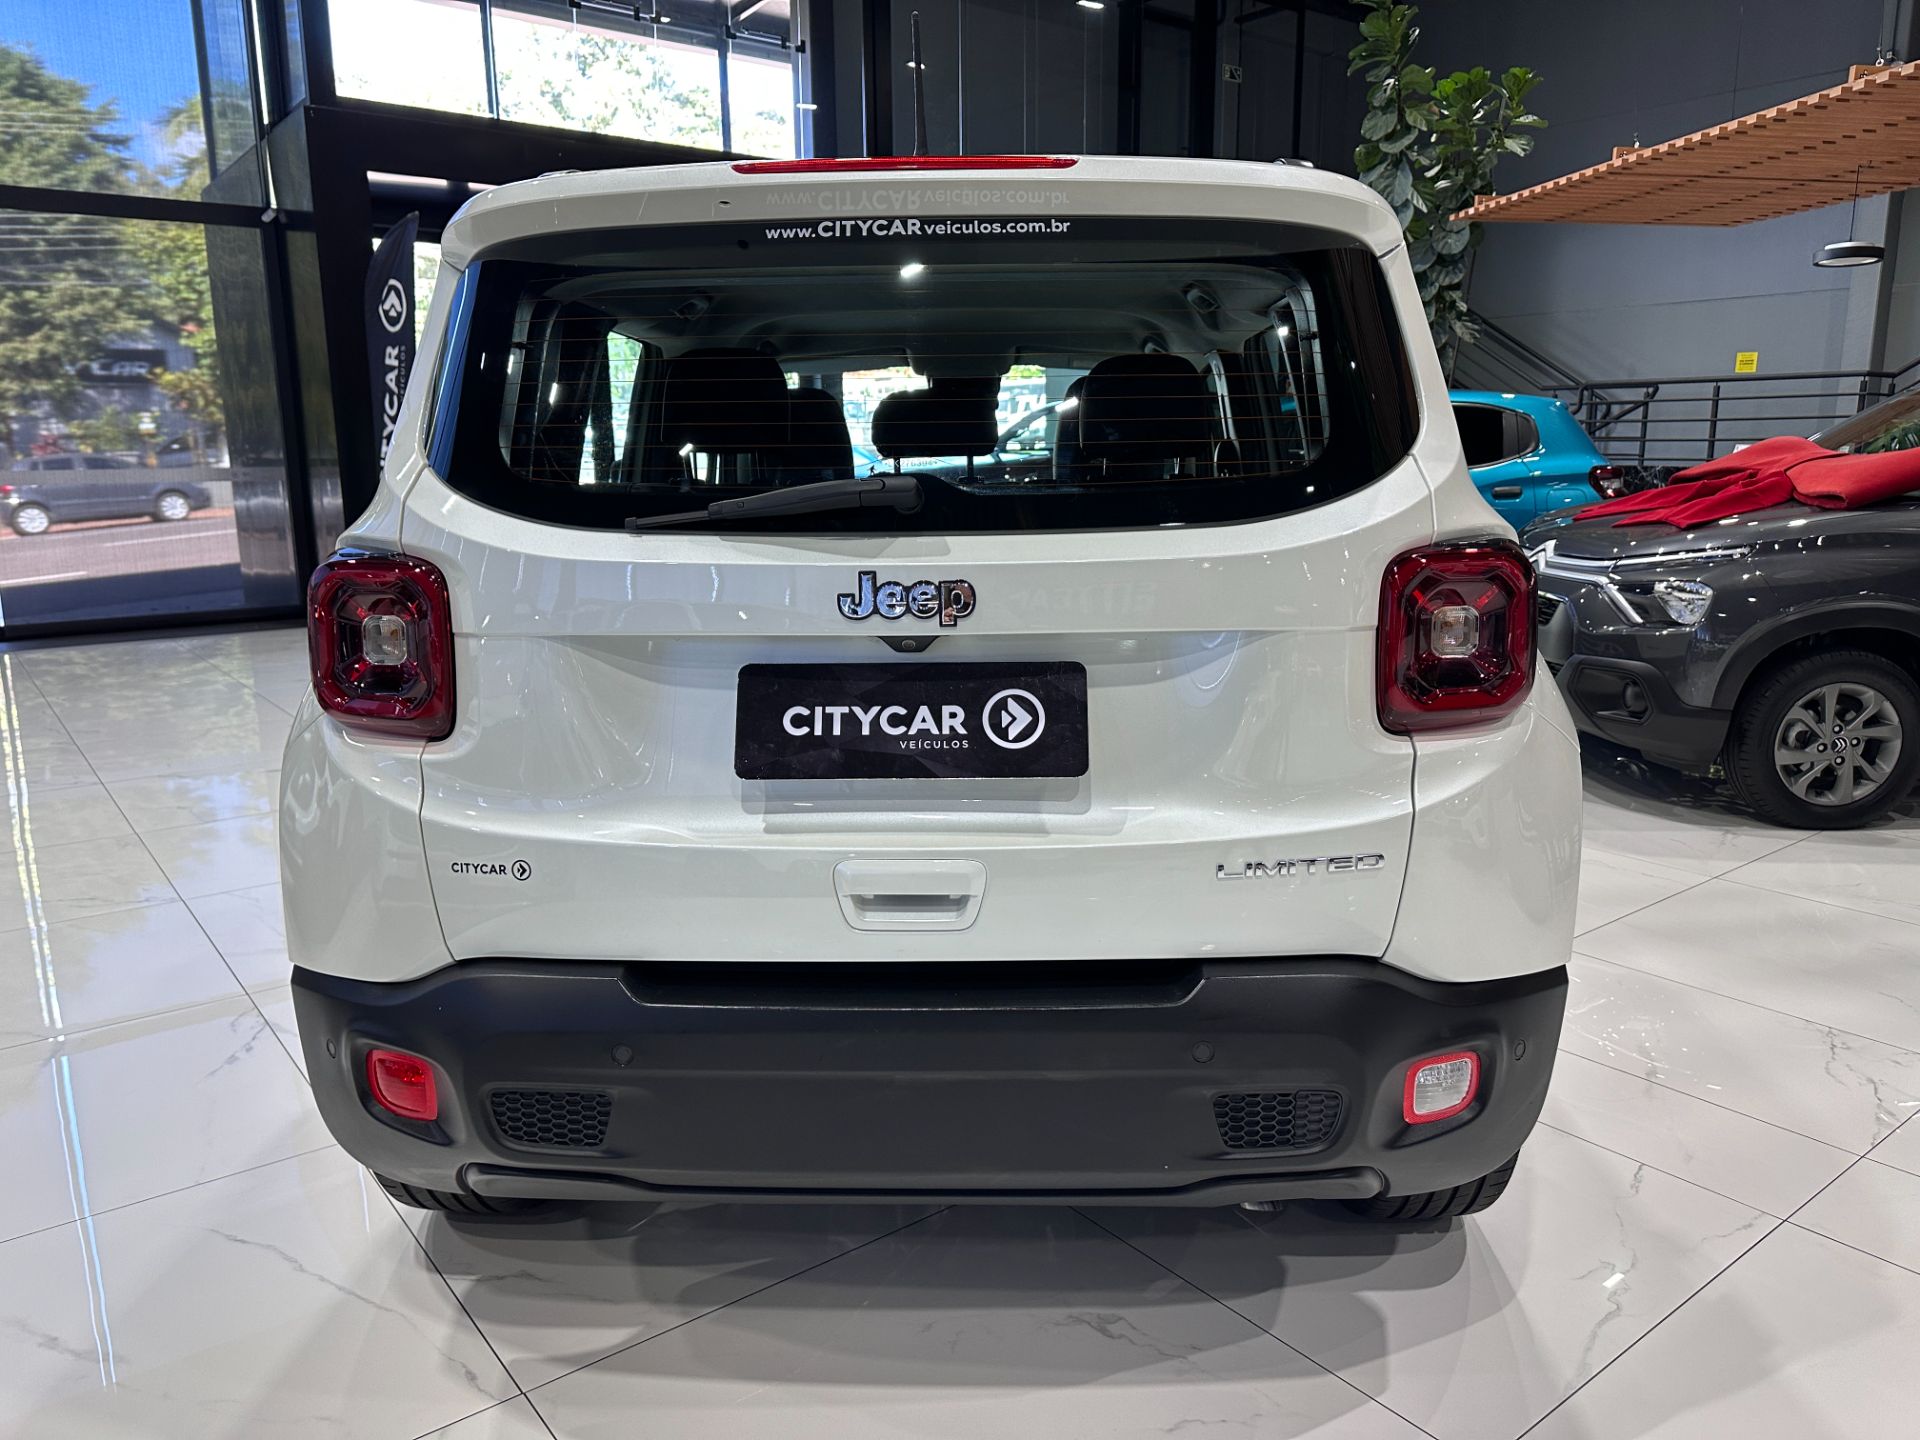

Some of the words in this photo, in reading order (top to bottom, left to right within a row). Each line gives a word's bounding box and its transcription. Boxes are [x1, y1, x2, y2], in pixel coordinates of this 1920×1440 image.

[837, 570, 976, 627] Jeep
[782, 705, 968, 736] CITYCAR
[900, 739, 969, 749] VEÍCULOS
[451, 862, 507, 875] CITYCAR
[1216, 853, 1386, 880] LIMITED
